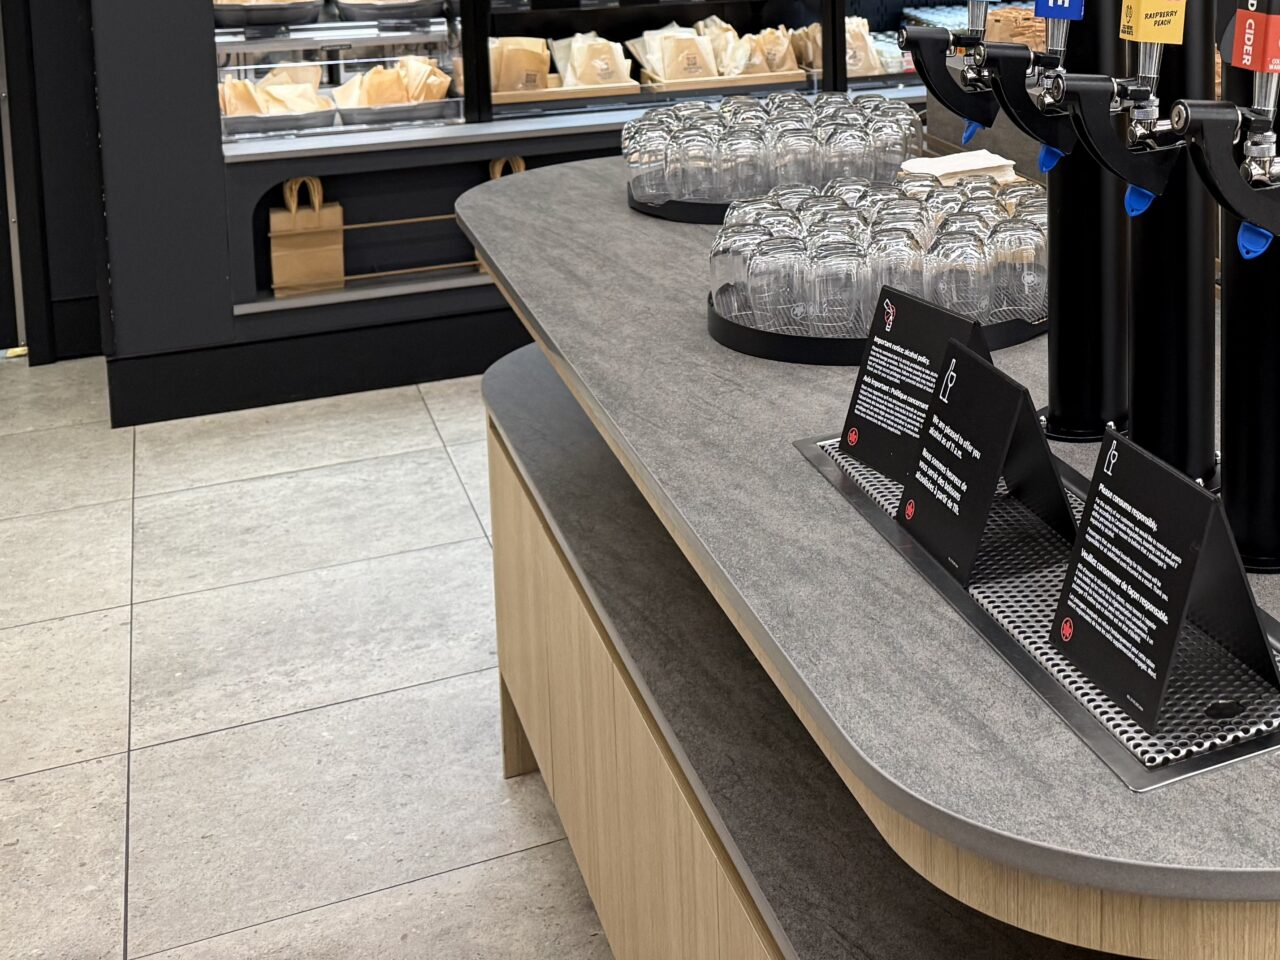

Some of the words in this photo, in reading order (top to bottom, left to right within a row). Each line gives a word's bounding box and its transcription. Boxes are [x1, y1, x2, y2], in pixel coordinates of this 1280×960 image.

[1242, 19, 1255, 66] CIDER
[1098, 483, 1113, 498] Please
[1112, 493, 1132, 512] consume
[1131, 508, 1157, 531] responsibly.
